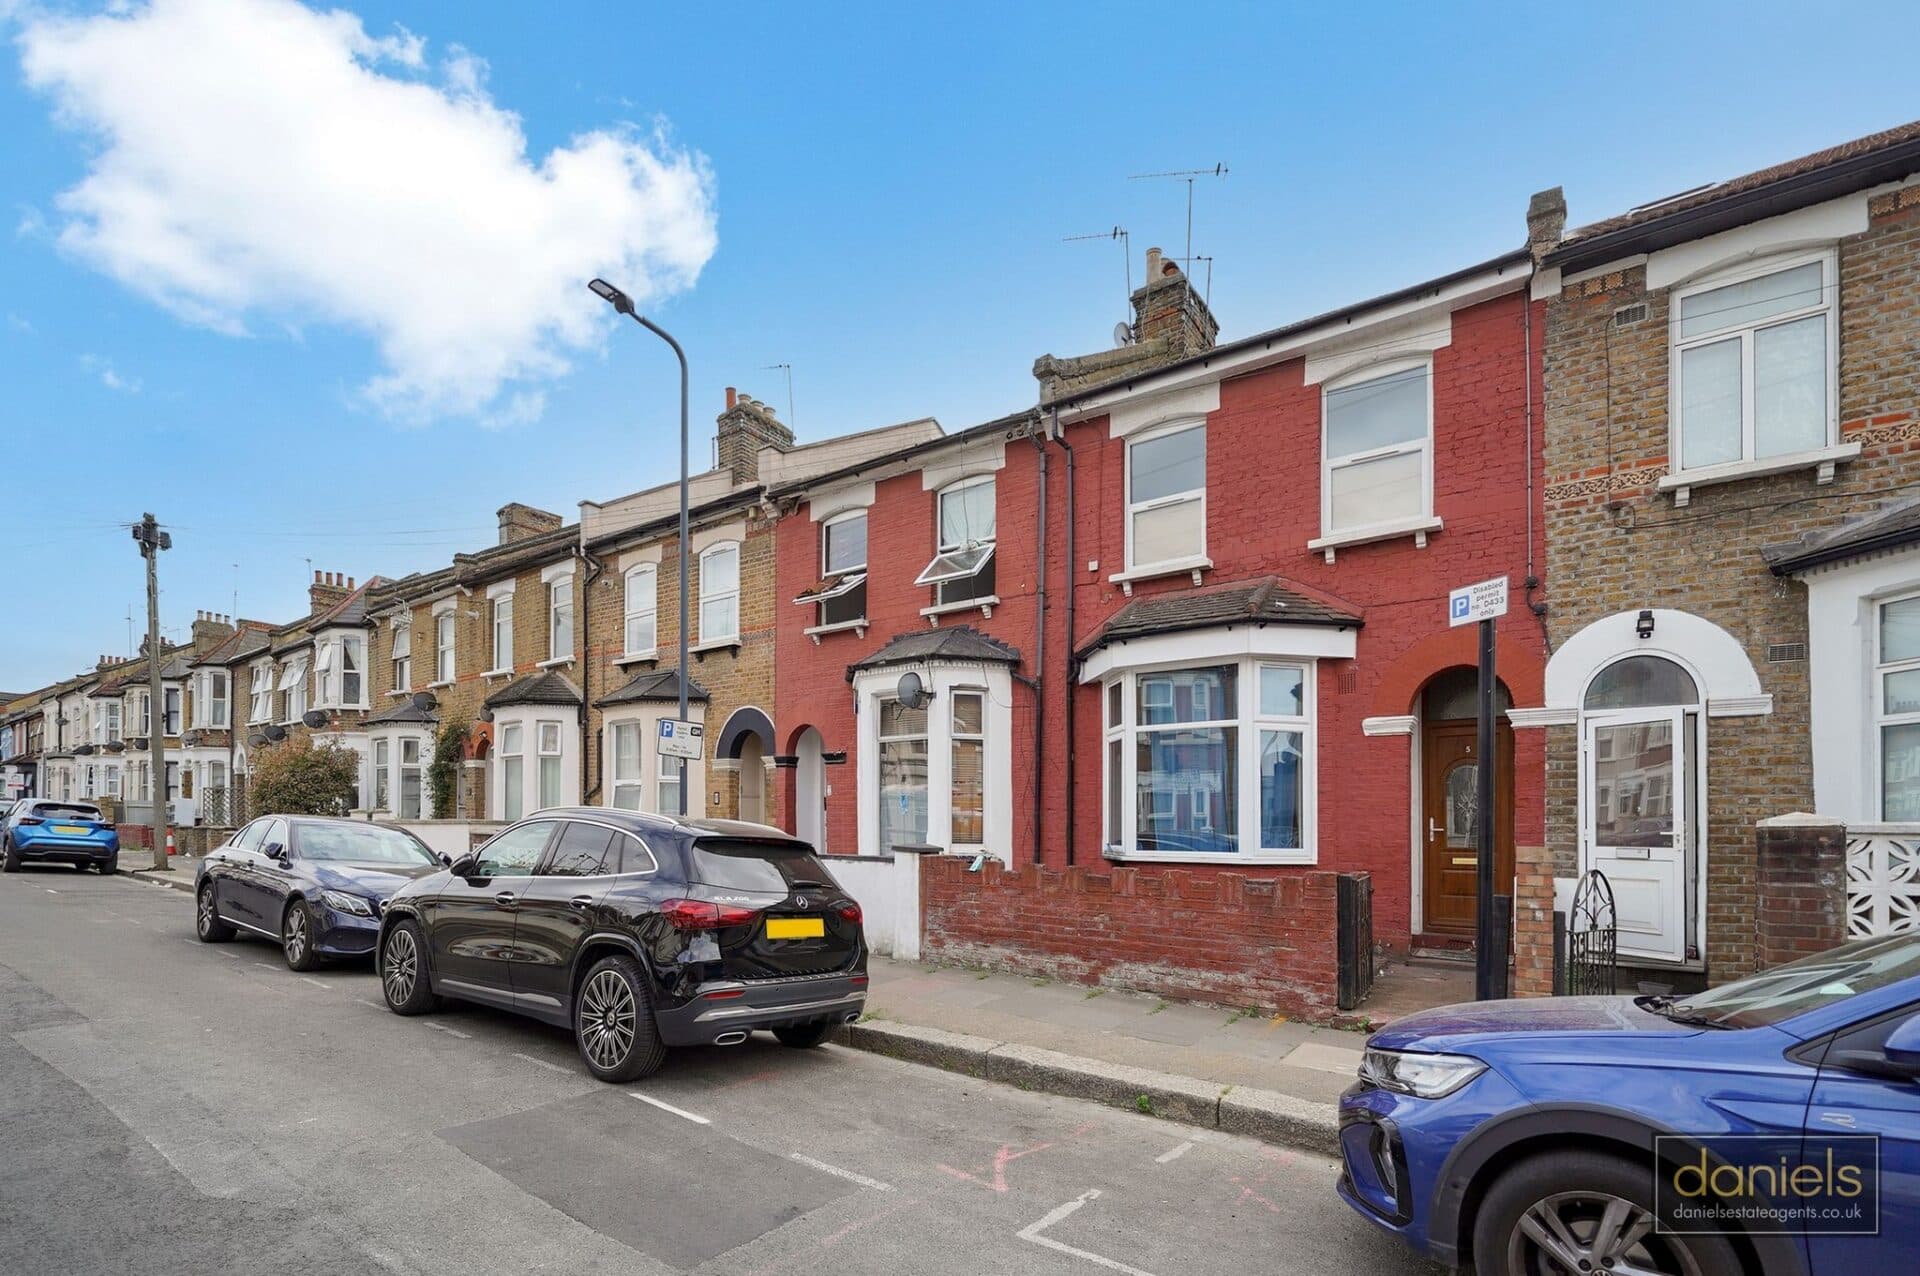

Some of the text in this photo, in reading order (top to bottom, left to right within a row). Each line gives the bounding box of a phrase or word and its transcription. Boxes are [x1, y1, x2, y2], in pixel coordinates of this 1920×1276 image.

[1473, 581, 1504, 594] Disabled
[1456, 598, 1467, 617] P
[663, 723, 672, 736] P
